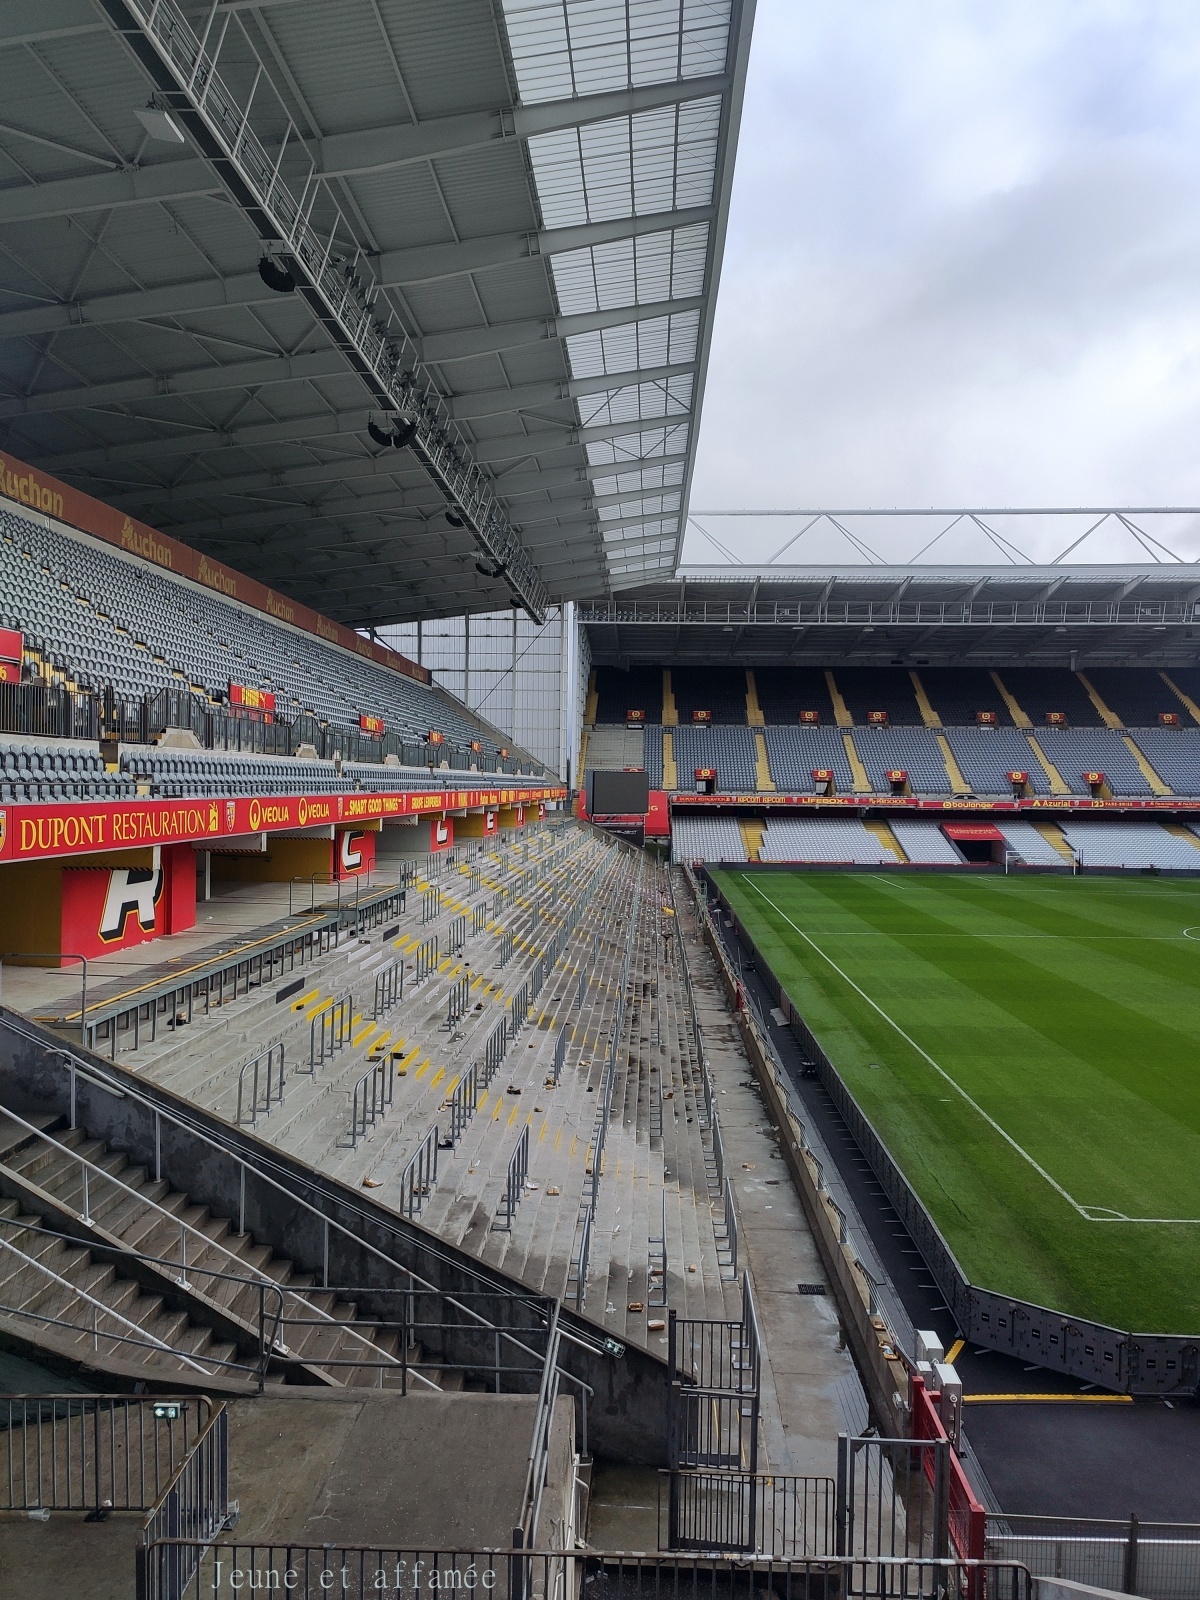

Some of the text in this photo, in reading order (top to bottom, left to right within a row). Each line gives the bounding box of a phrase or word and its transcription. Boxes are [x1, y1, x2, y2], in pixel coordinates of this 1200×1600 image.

[121, 516, 172, 567] Auchan
[307, 803, 330, 819] VEOLIA
[952, 801, 996, 810] boulanger
[1042, 799, 1071, 808] Azurial
[1091, 799, 1105, 808] 123
[261, 806, 290, 824] VEOLIA
[20, 814, 107, 851] DUPONT
[113, 809, 206, 841] RESTAURATION
